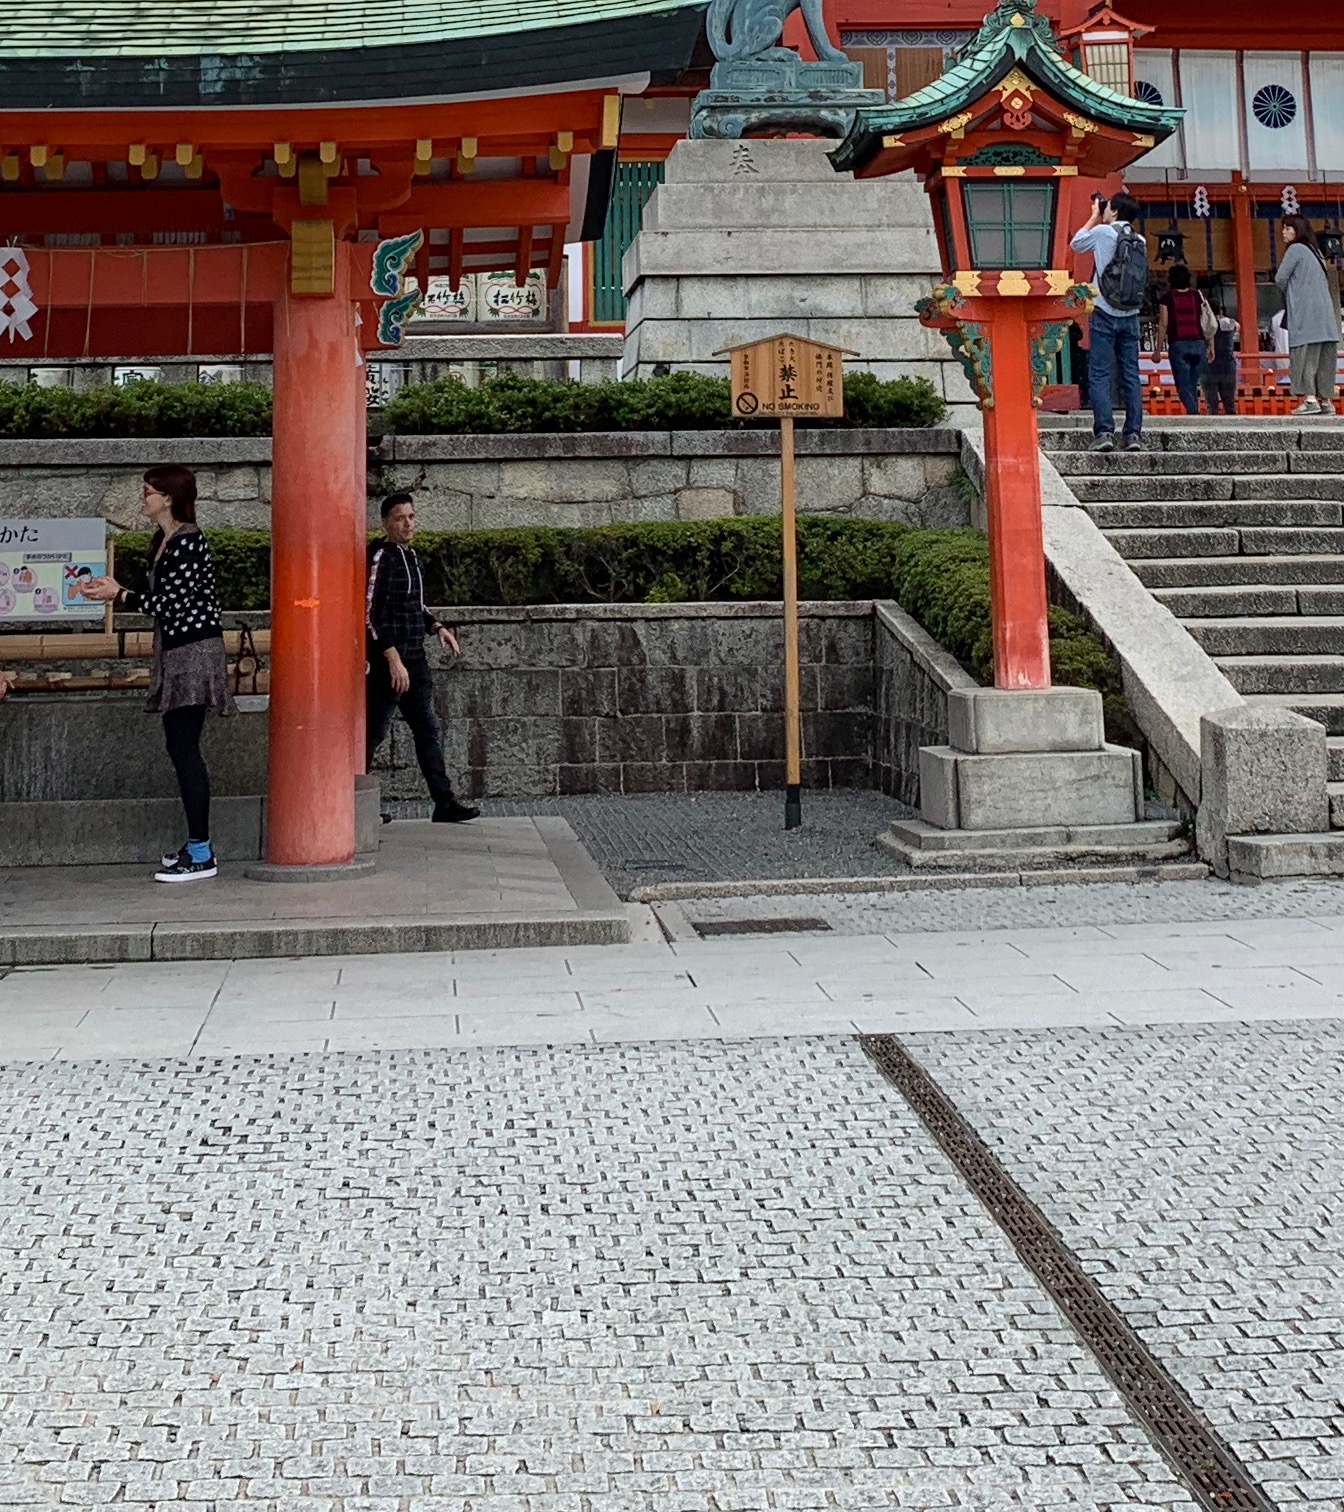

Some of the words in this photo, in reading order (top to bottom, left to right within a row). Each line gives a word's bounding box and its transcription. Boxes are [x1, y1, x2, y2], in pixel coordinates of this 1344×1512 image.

[729, 144, 760, 175] 奉
[493, 289, 538, 307] 松竹梅
[778, 364, 798, 400] 禁止
[762, 402, 775, 411] NO
[778, 402, 820, 411] SMOKING
